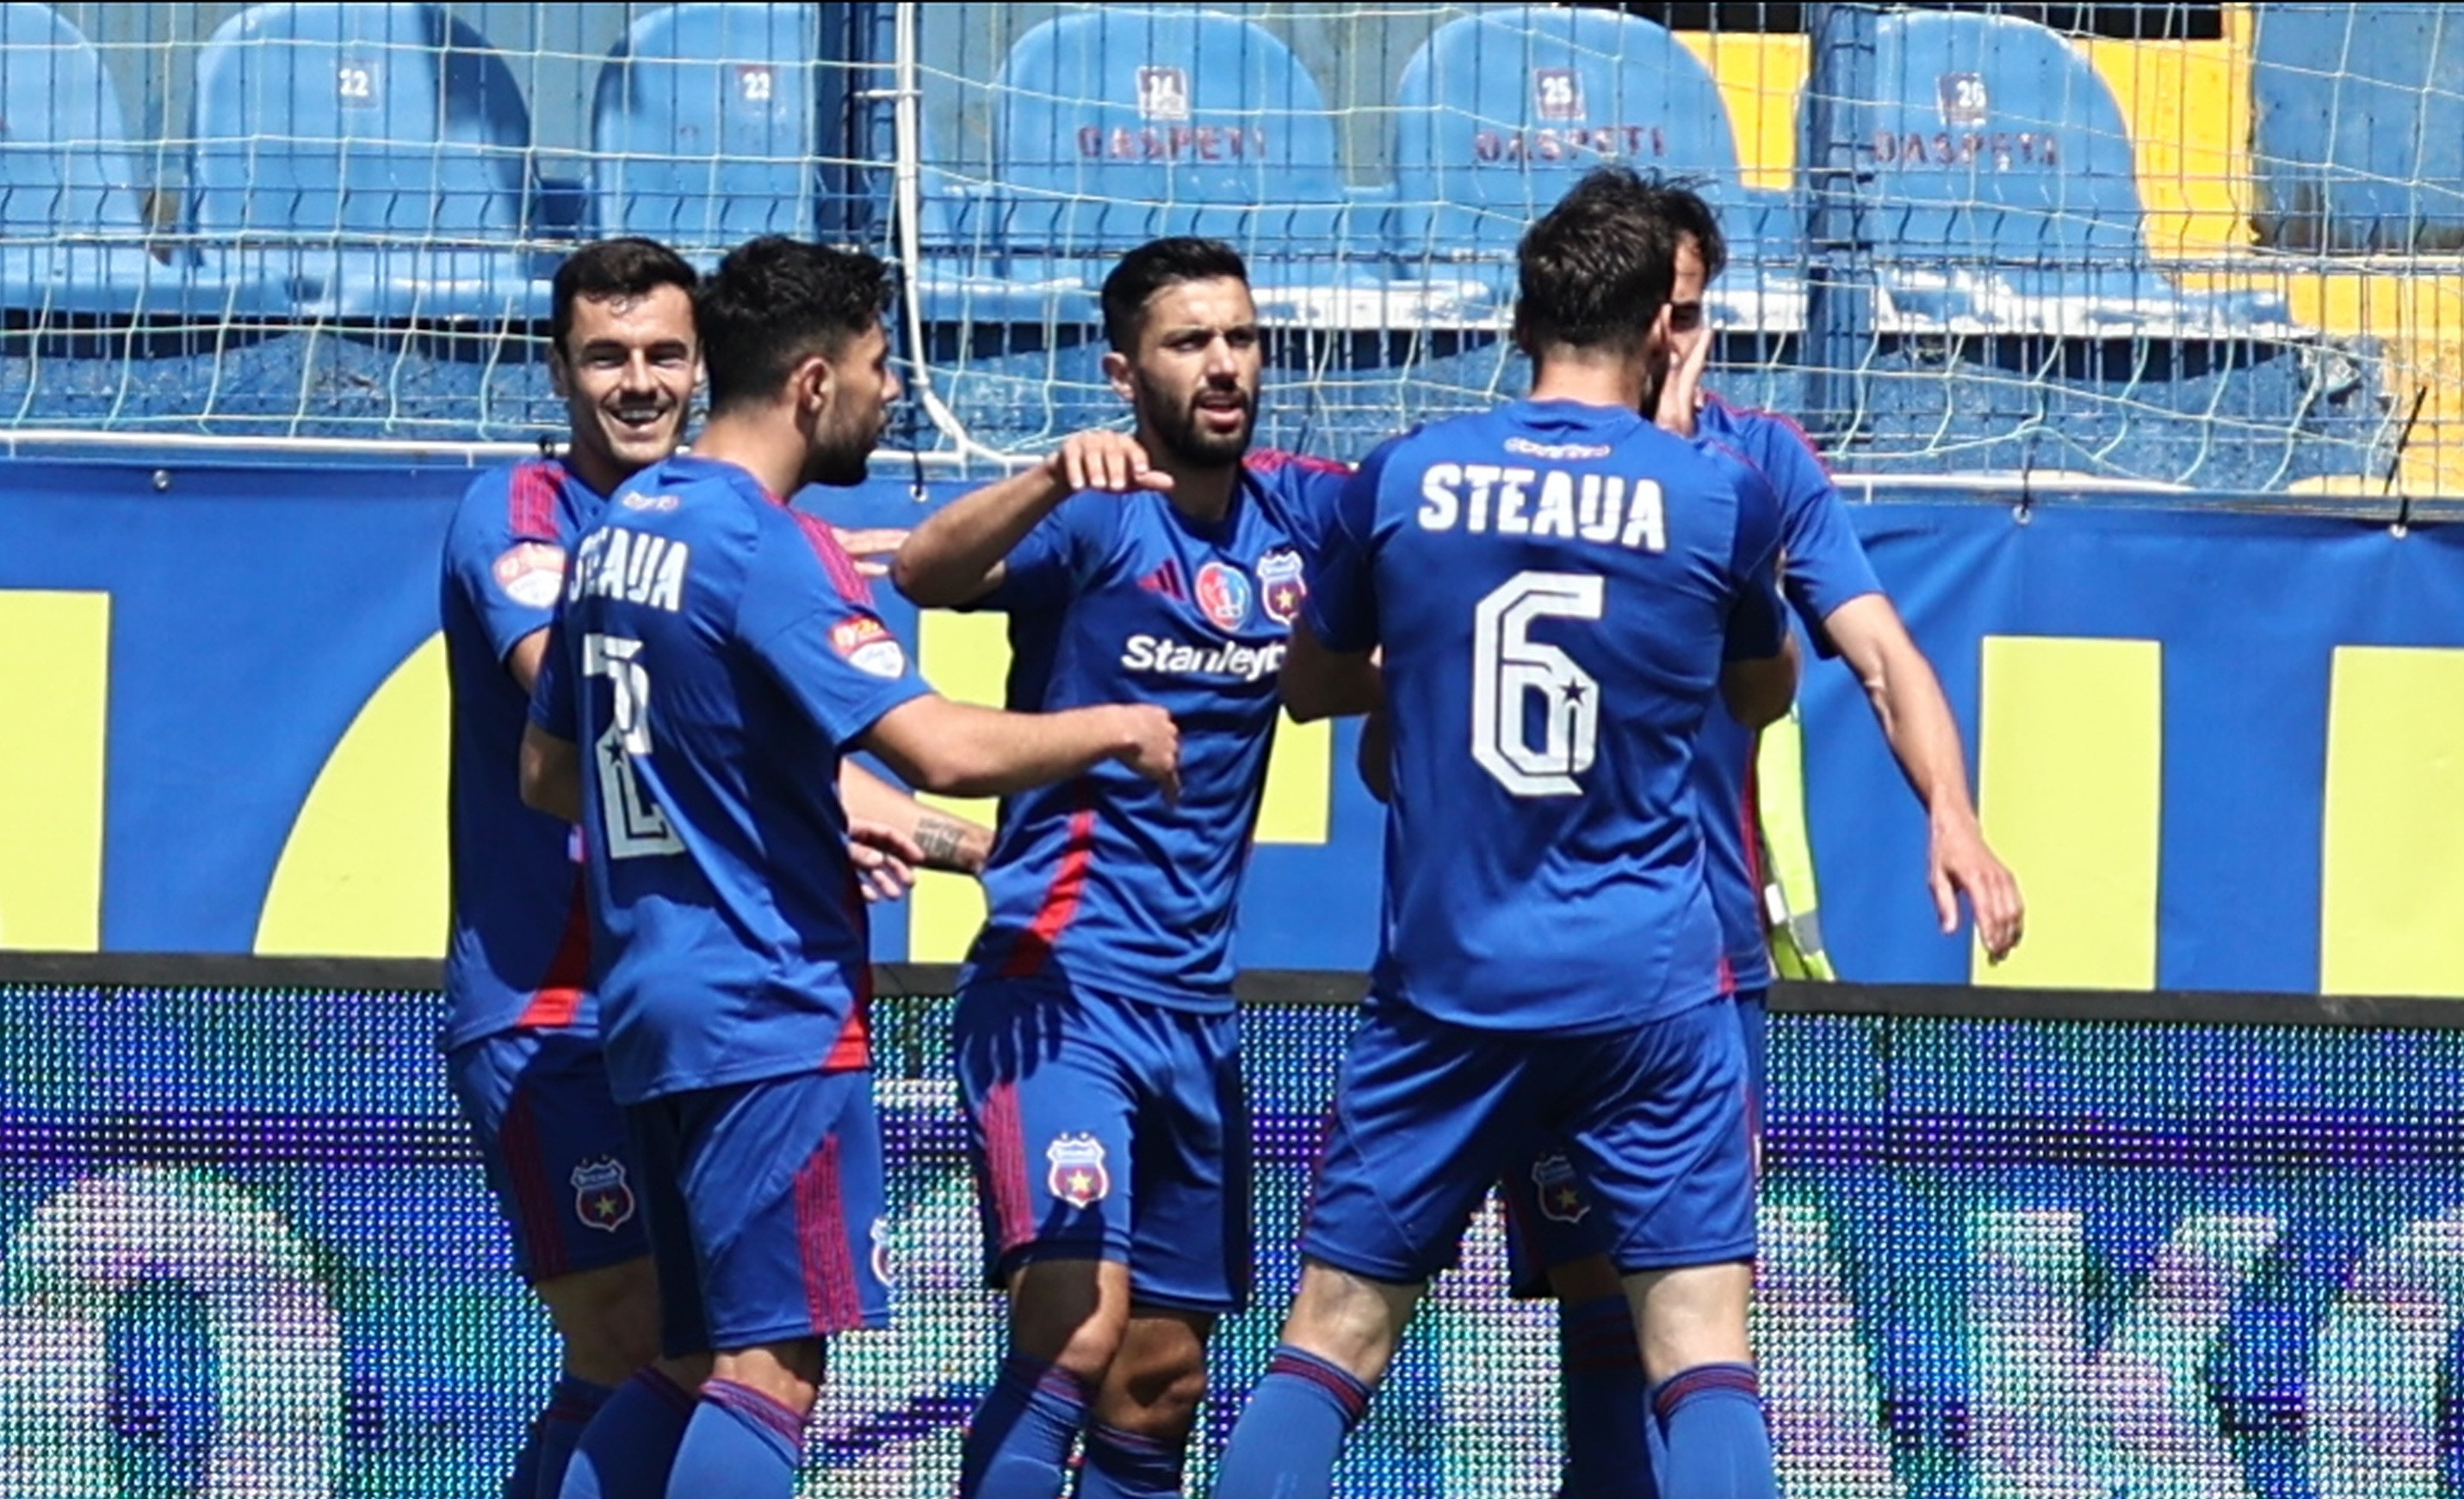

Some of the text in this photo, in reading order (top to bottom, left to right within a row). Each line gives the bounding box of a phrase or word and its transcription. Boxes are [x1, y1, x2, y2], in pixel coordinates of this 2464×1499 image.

[339, 69, 368, 96] 22
[1542, 76, 1572, 105] 25
[1956, 80, 1987, 108] 26
[1417, 462, 1667, 552] STEAUA
[1471, 571, 1604, 796] 6
